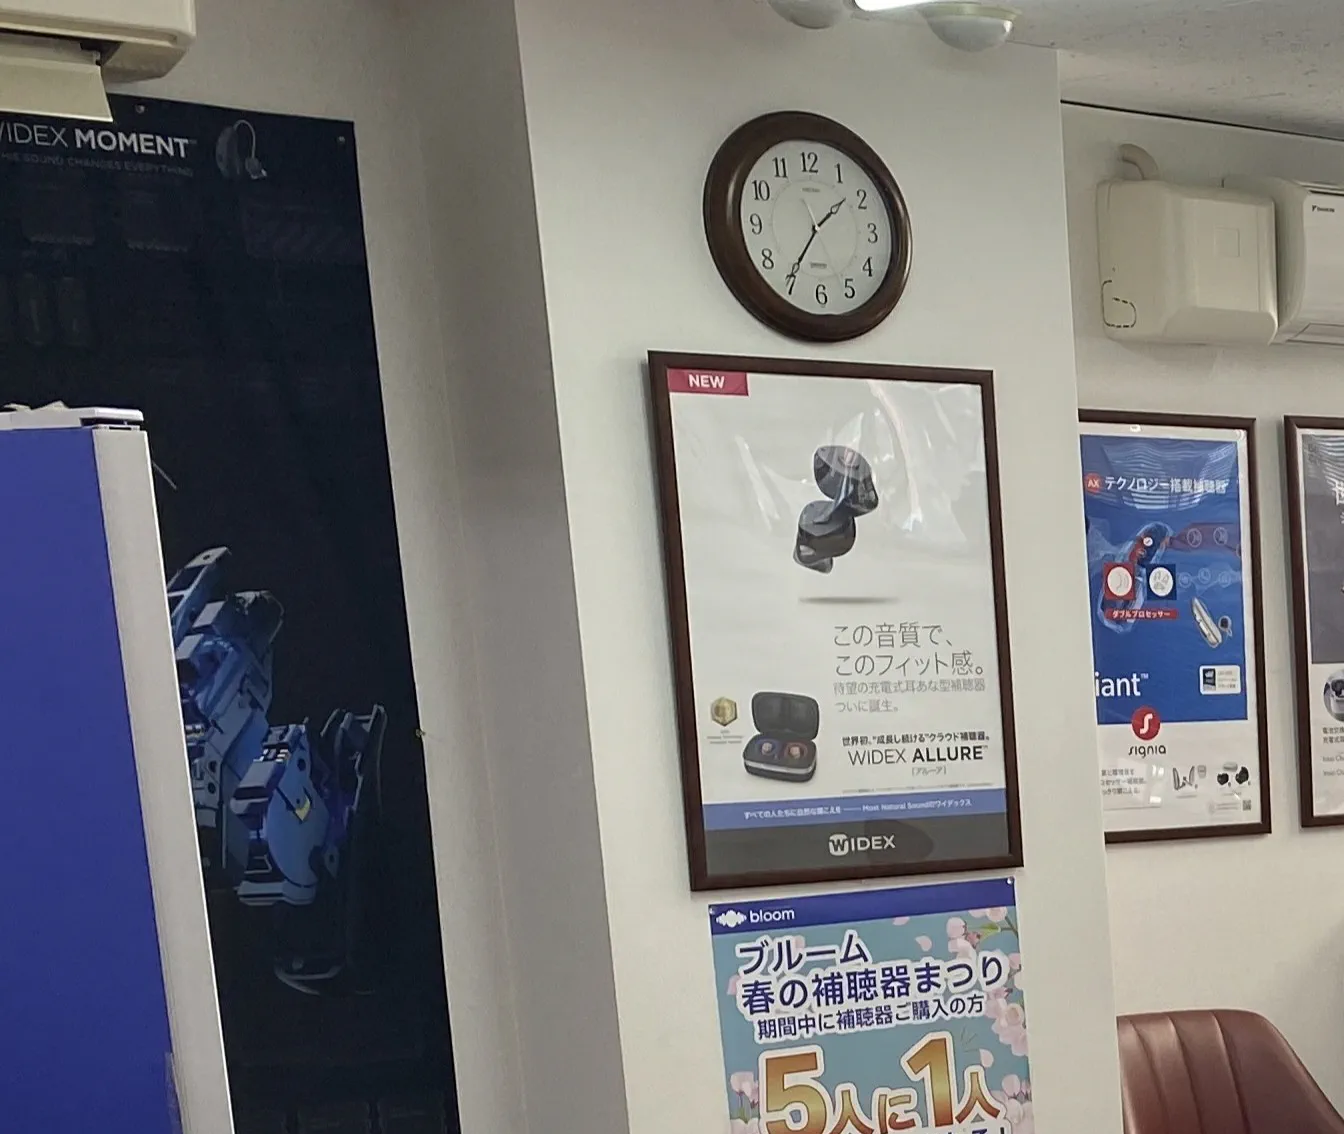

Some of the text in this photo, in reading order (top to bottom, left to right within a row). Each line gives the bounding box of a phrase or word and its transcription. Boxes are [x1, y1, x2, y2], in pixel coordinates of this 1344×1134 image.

[0, 121, 190, 159] IDEX MOMENT
[772, 157, 788, 178] 11
[800, 152, 819, 174] 12
[834, 163, 844, 184] 1
[751, 180, 770, 201] 10
[856, 190, 867, 210] 2
[750, 213, 763, 235] 9
[867, 223, 878, 243] 3
[761, 248, 774, 270] 8
[862, 257, 873, 277] 4
[815, 284, 828, 305] 6
[843, 278, 856, 299] 5
[688, 374, 726, 390] NEW
[1087, 479, 1100, 489] AX
[833, 622, 953, 648] この音質で、
[835, 649, 984, 677] このフィット感。
[848, 745, 984, 766] WIDEX ALLURE
[1128, 744, 1167, 759] signia
[829, 833, 896, 857] WIDEX
[749, 908, 796, 923] bloom
[739, 934, 869, 975] ブルーム
[742, 955, 1004, 1015] 春の補聴器まつり
[757, 994, 985, 1040] 期間中に補聴器ご購入の方
